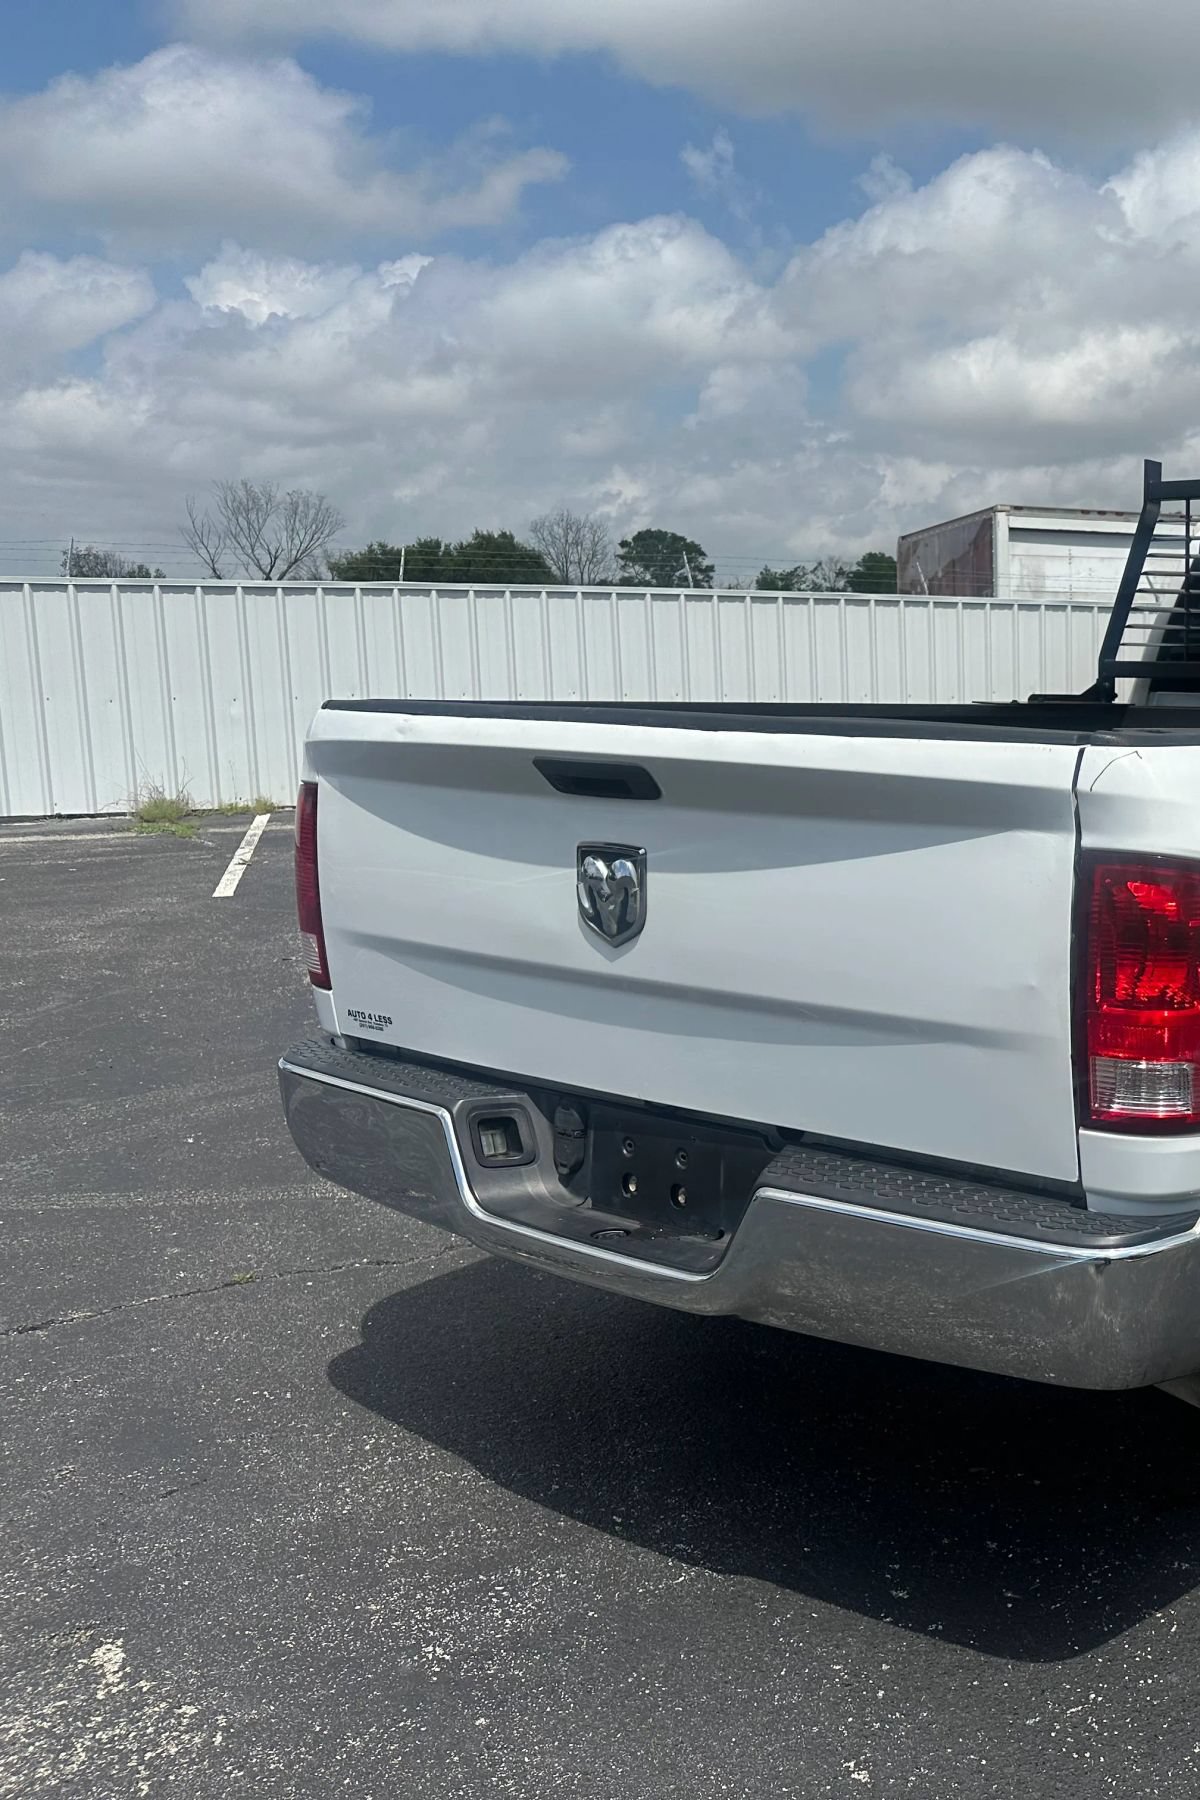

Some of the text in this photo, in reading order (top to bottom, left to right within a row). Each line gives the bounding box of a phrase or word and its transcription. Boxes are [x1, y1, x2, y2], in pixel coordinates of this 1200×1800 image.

[347, 1009, 366, 1020] AUTO
[367, 1013, 373, 1021] 4
[373, 1014, 393, 1025] LESS
